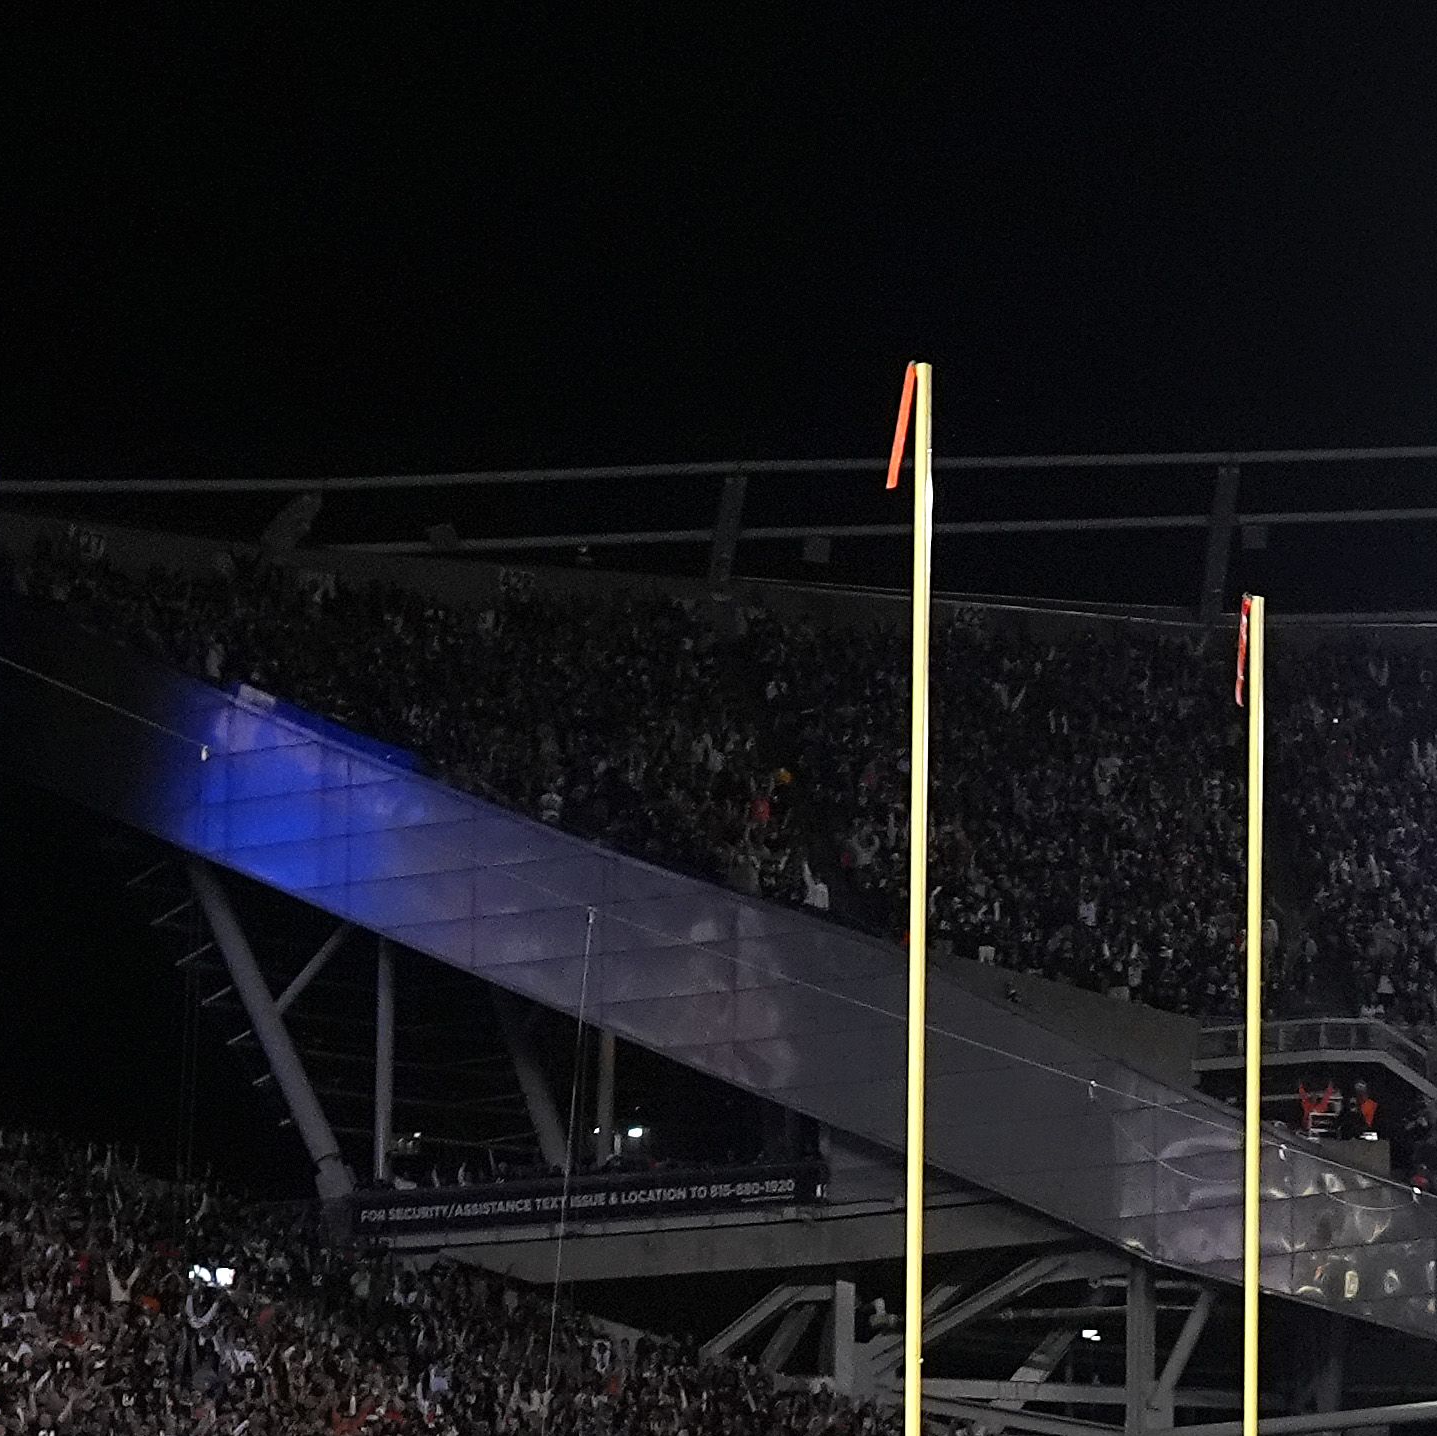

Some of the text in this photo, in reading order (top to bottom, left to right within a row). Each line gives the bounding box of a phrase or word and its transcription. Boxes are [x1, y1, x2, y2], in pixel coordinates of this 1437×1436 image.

[361, 1209, 385, 1222] FOR
[621, 1187, 688, 1204] LOCATION
[690, 1186, 707, 1199] TO
